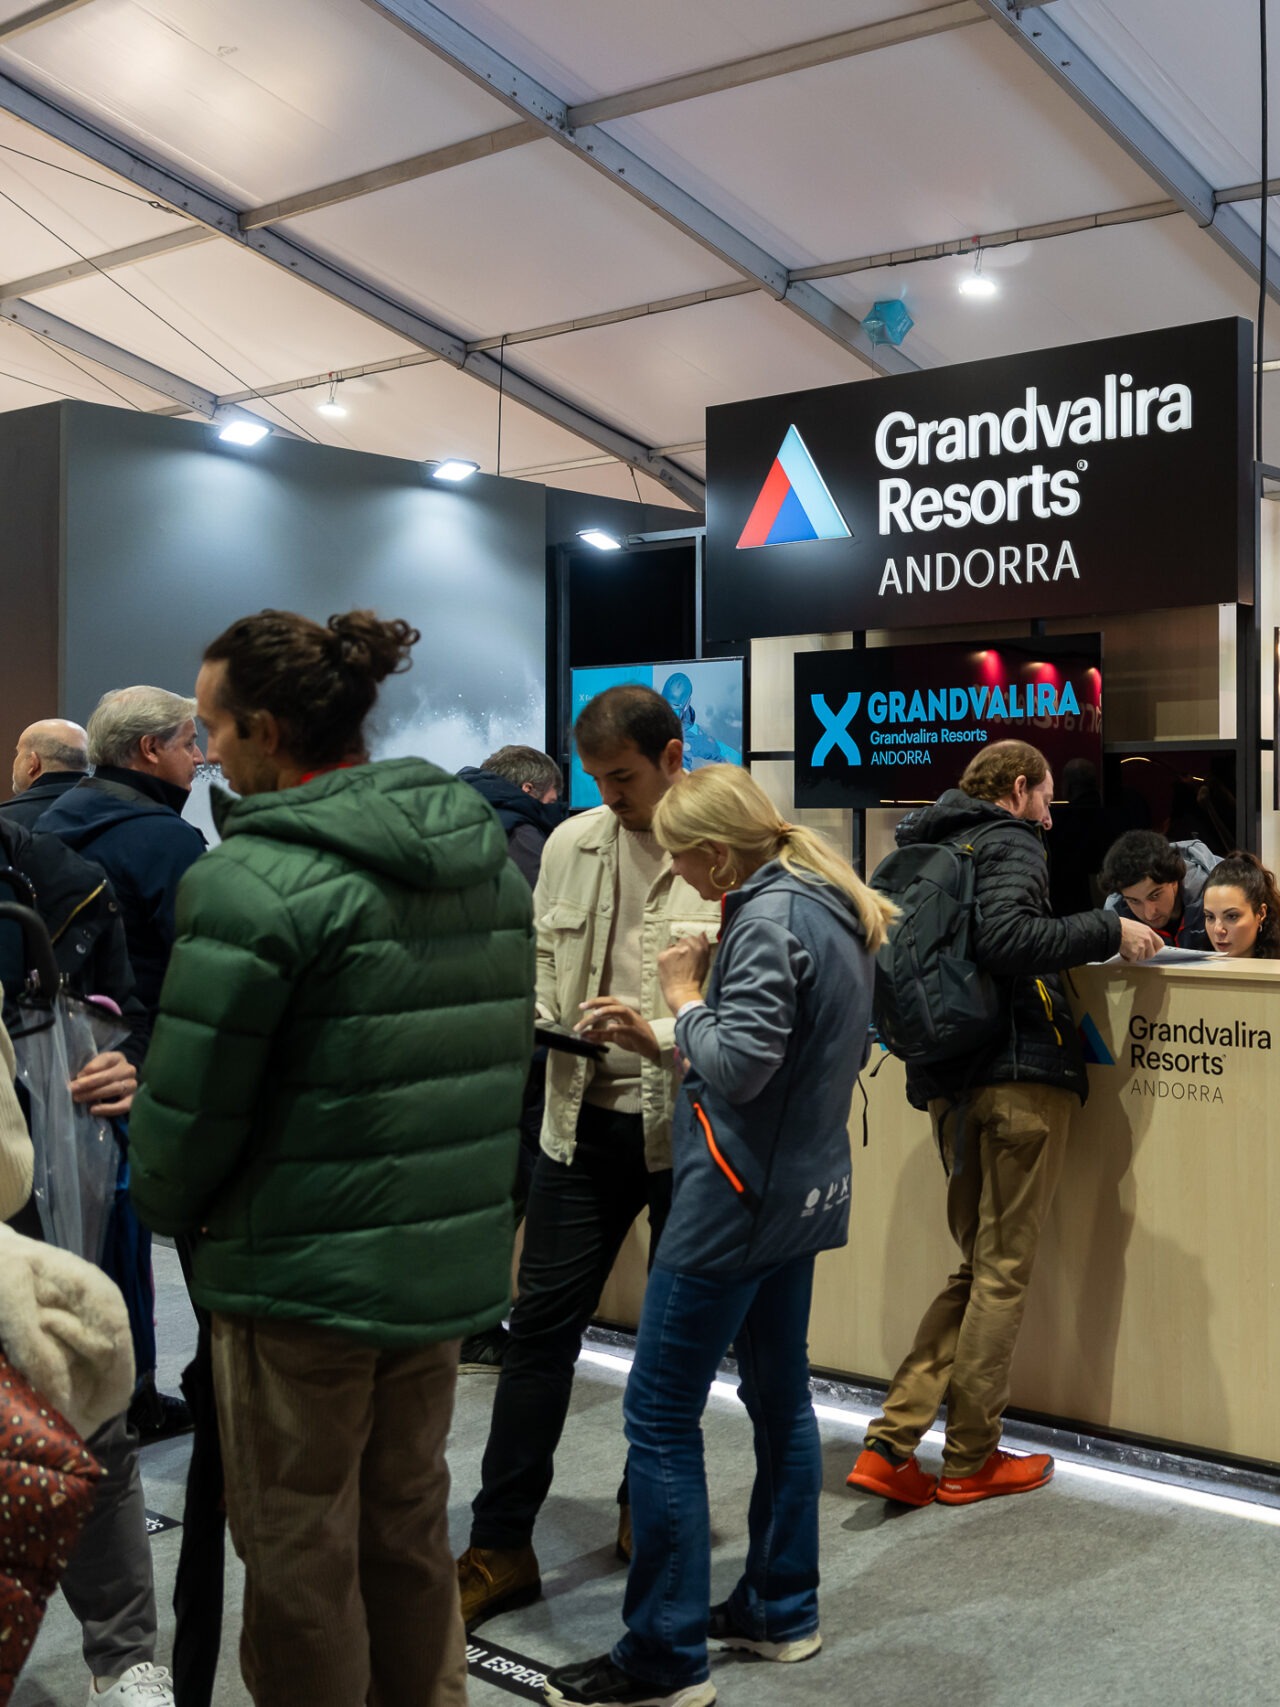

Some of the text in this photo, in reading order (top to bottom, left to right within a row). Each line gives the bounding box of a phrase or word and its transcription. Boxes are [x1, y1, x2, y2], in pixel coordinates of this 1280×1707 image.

[875, 373, 1192, 469] Grandvalira
[878, 540, 1080, 595] ANDORRA
[867, 680, 1081, 725] GRANDVALIRA
[870, 728, 988, 746] Grandvalira Resorts
[870, 750, 932, 766] ANDORRA
[1129, 1015, 1271, 1050] Grandvalira
[1131, 1079, 1224, 1104] ANDORRA
